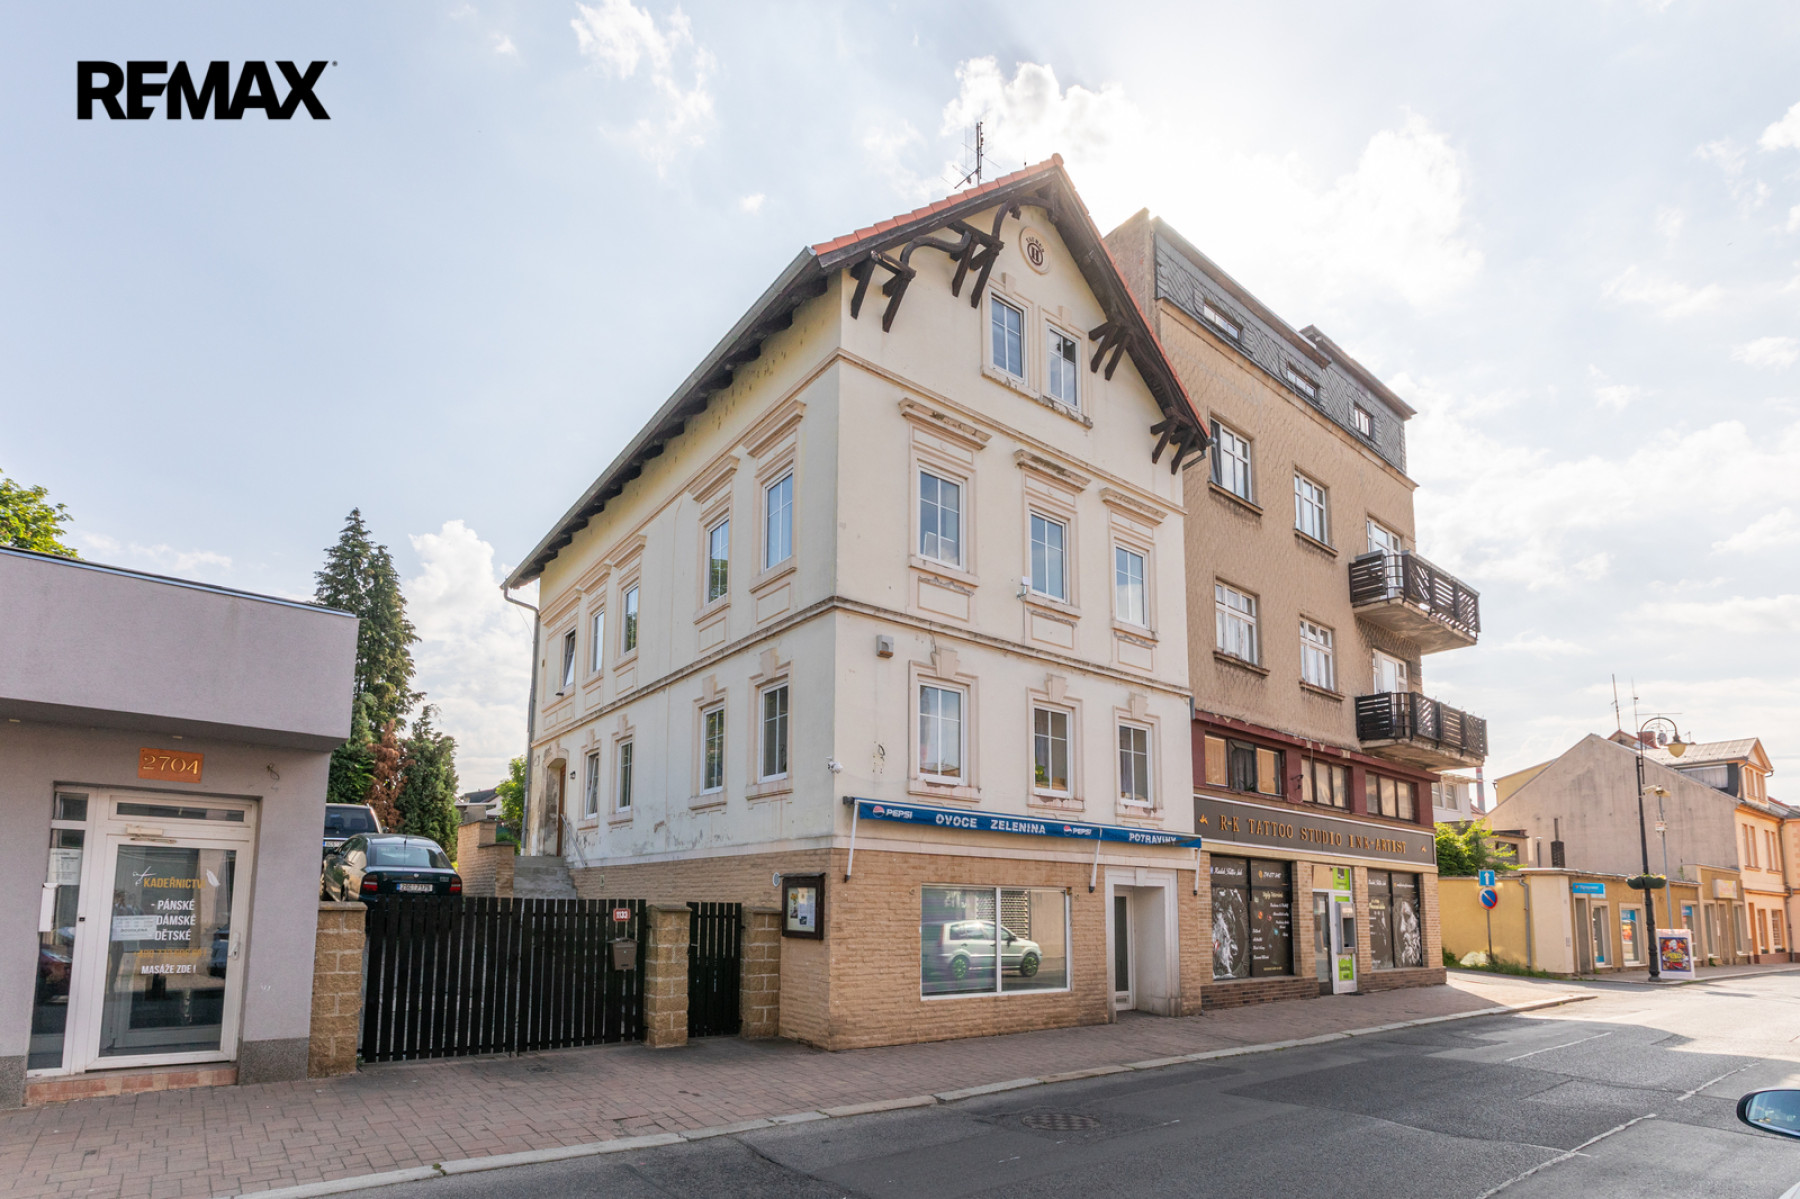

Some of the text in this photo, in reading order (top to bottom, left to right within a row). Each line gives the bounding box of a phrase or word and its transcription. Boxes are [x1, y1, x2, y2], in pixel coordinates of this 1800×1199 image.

[143, 755, 199, 775] 2704
[885, 808, 913, 820] PEPSI
[935, 813, 1046, 835] OVOCE ZELENINA
[1072, 827, 1092, 836] PEPSI
[1220, 815, 1240, 832] R-K
[1248, 818, 1294, 839] TATTOO
[1300, 827, 1343, 847] STUDIO
[157, 898, 195, 910] PÁNSKÉ
[156, 914, 196, 925] DÁMSKÉ
[154, 929, 191, 940] DĚTSKÉ
[141, 964, 174, 974] MASÁŽE
[176, 964, 191, 973] ZDE
